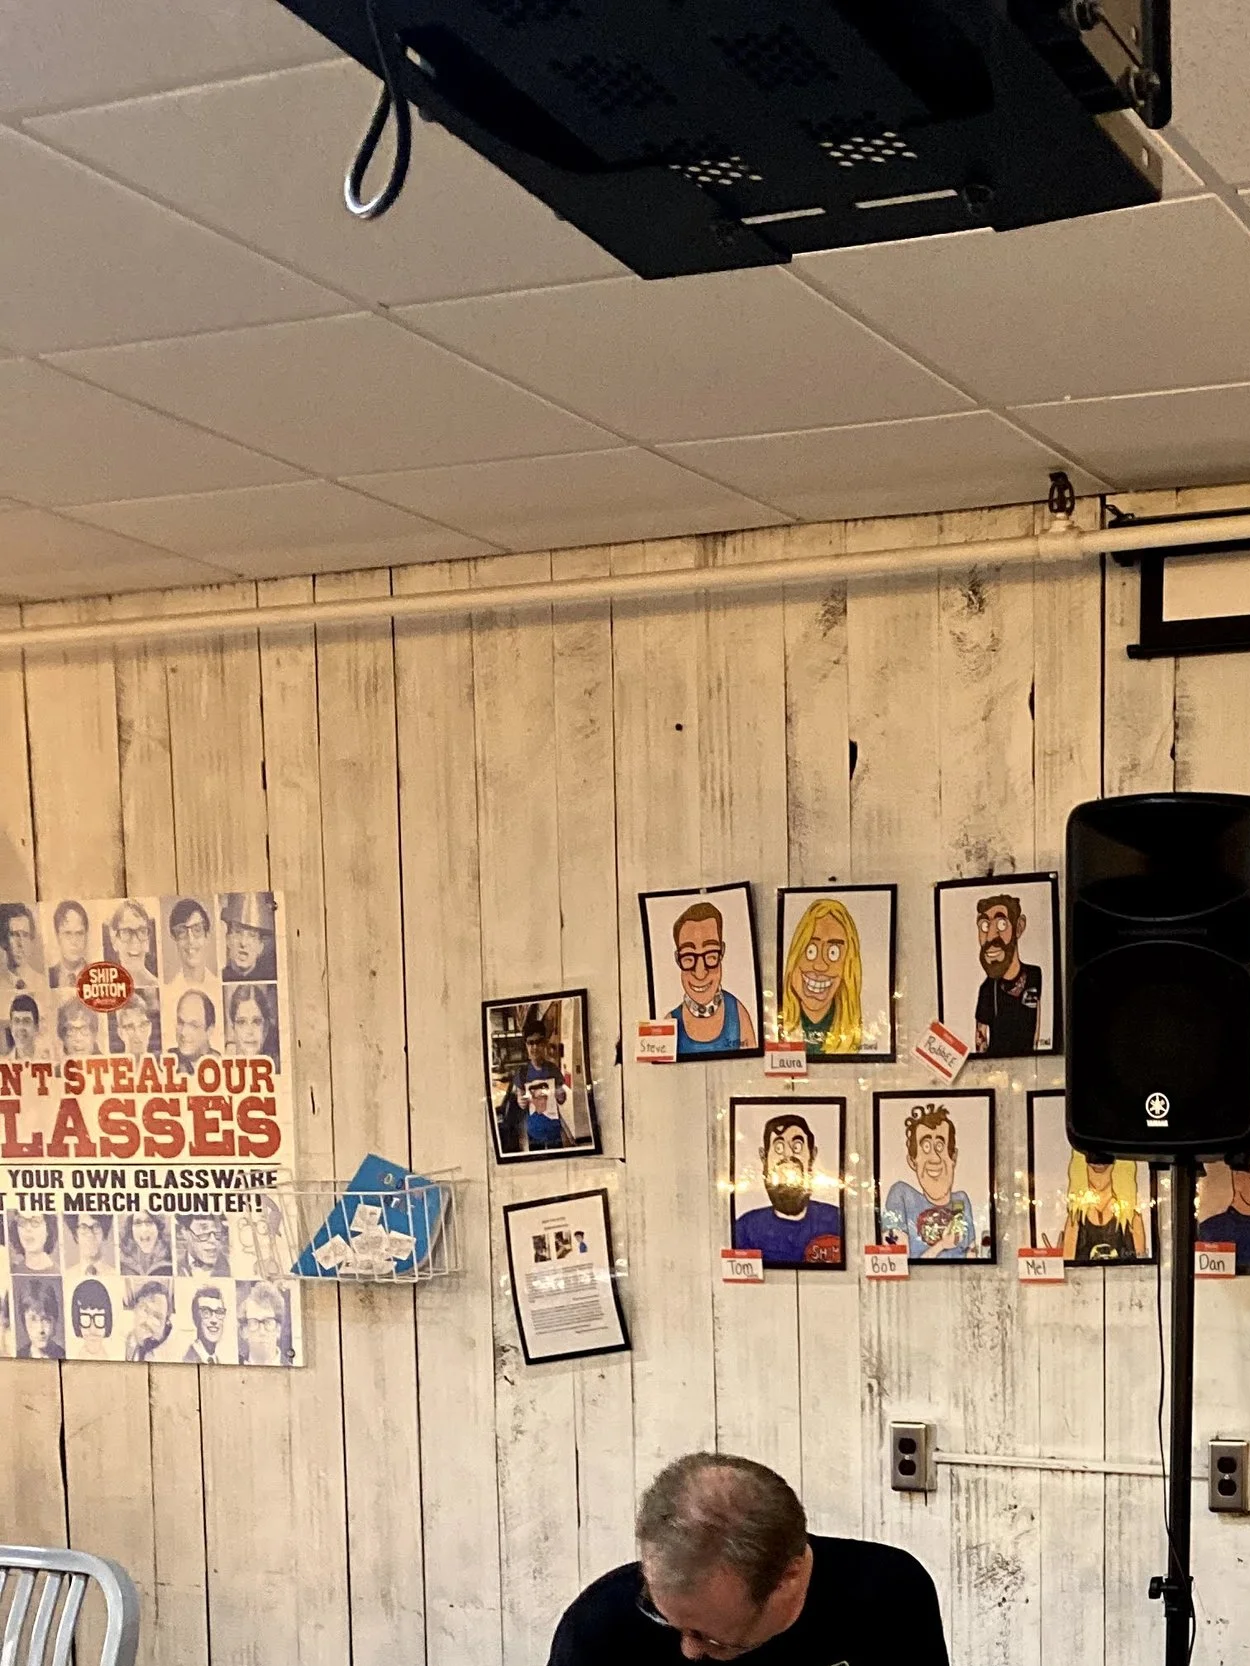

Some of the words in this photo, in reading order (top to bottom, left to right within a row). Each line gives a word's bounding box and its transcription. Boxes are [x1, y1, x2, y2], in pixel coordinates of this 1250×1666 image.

[88, 968, 119, 984] SHIP
[82, 983, 127, 1000] BOTTOM
[640, 1039, 667, 1053] Steve
[770, 1053, 804, 1070] Laura
[63, 1058, 188, 1096] STEAL
[197, 1057, 275, 1094] OUR
[7, 1169, 64, 1190] YOUR
[71, 1169, 126, 1190] OWN
[134, 1168, 278, 1190] GLASSWARE
[15, 1192, 56, 1212] THE
[63, 1192, 140, 1212] MERCH
[148, 1192, 263, 1213] COUNTER!
[727, 1259, 760, 1278] Tom
[871, 1256, 897, 1274] Bob
[1026, 1260, 1047, 1276] Mel
[1199, 1254, 1226, 1272] Dan
